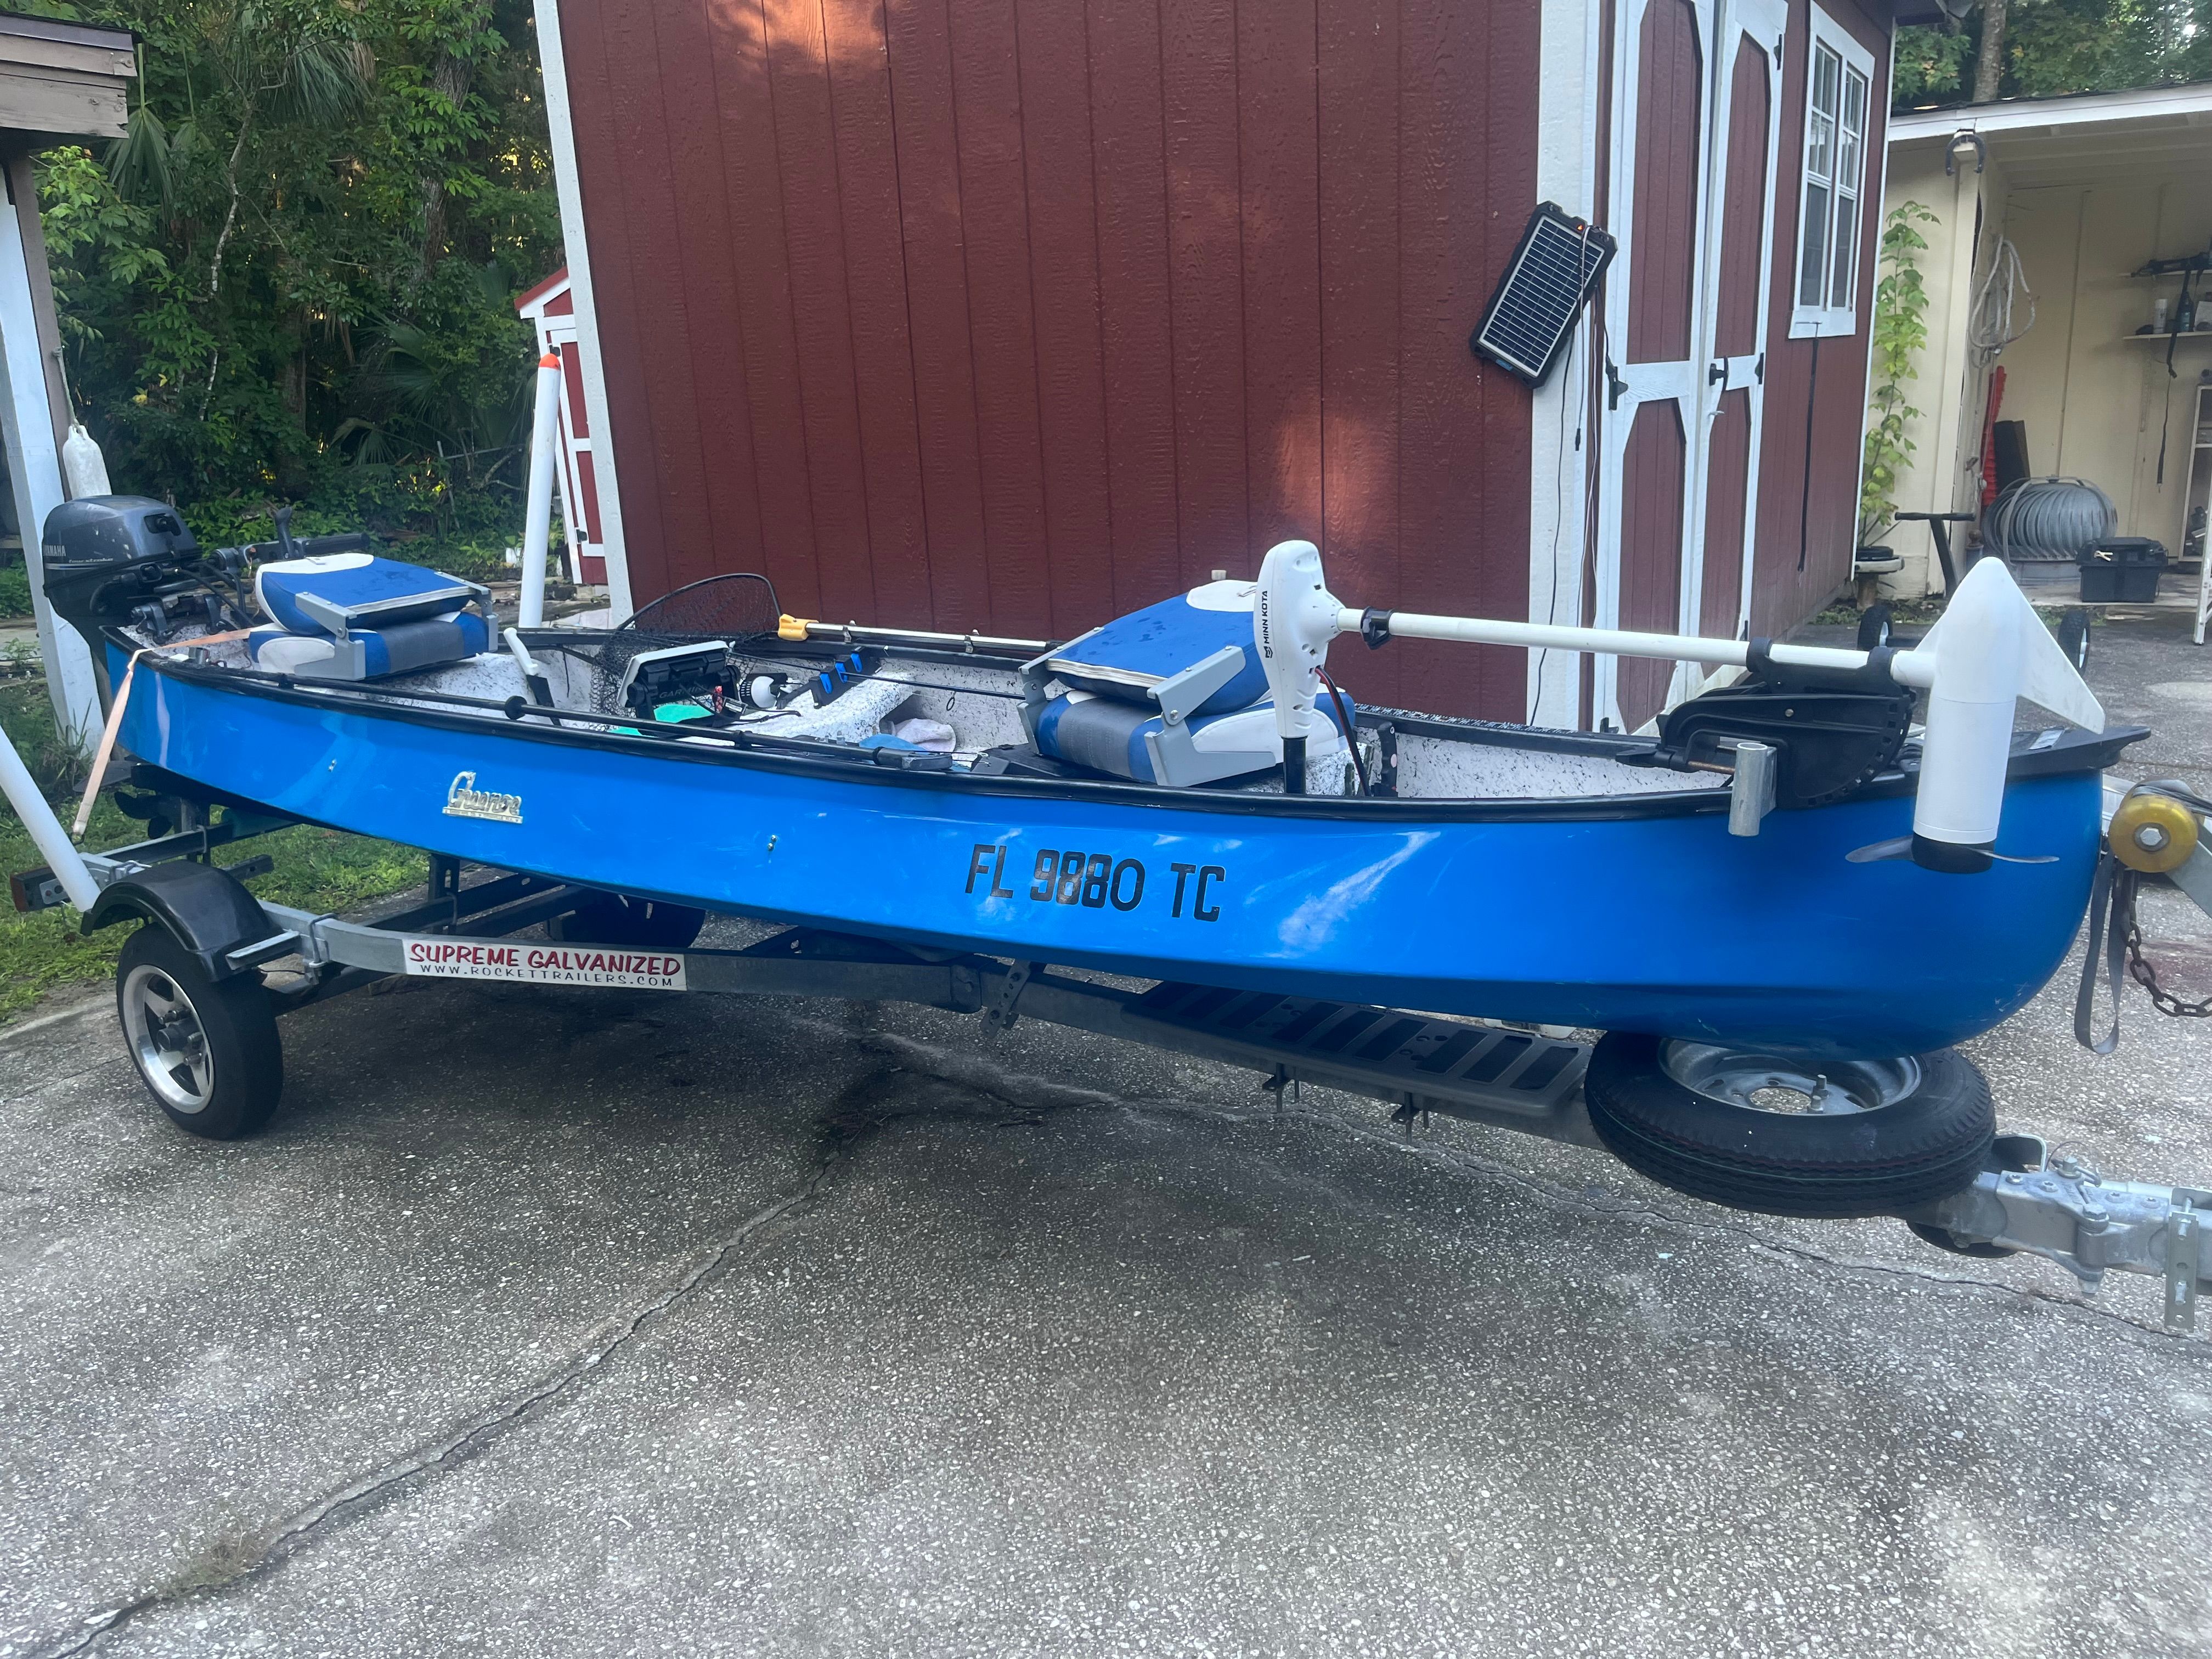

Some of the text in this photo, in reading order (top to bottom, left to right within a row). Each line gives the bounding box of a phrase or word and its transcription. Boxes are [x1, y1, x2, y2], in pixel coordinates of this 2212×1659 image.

[965, 843, 1226, 922] FL 9880 TC
[410, 943, 681, 976] SUPREME GALVANIZED
[420, 964, 673, 986] WWW.ROCKETTRAILERS.COM
